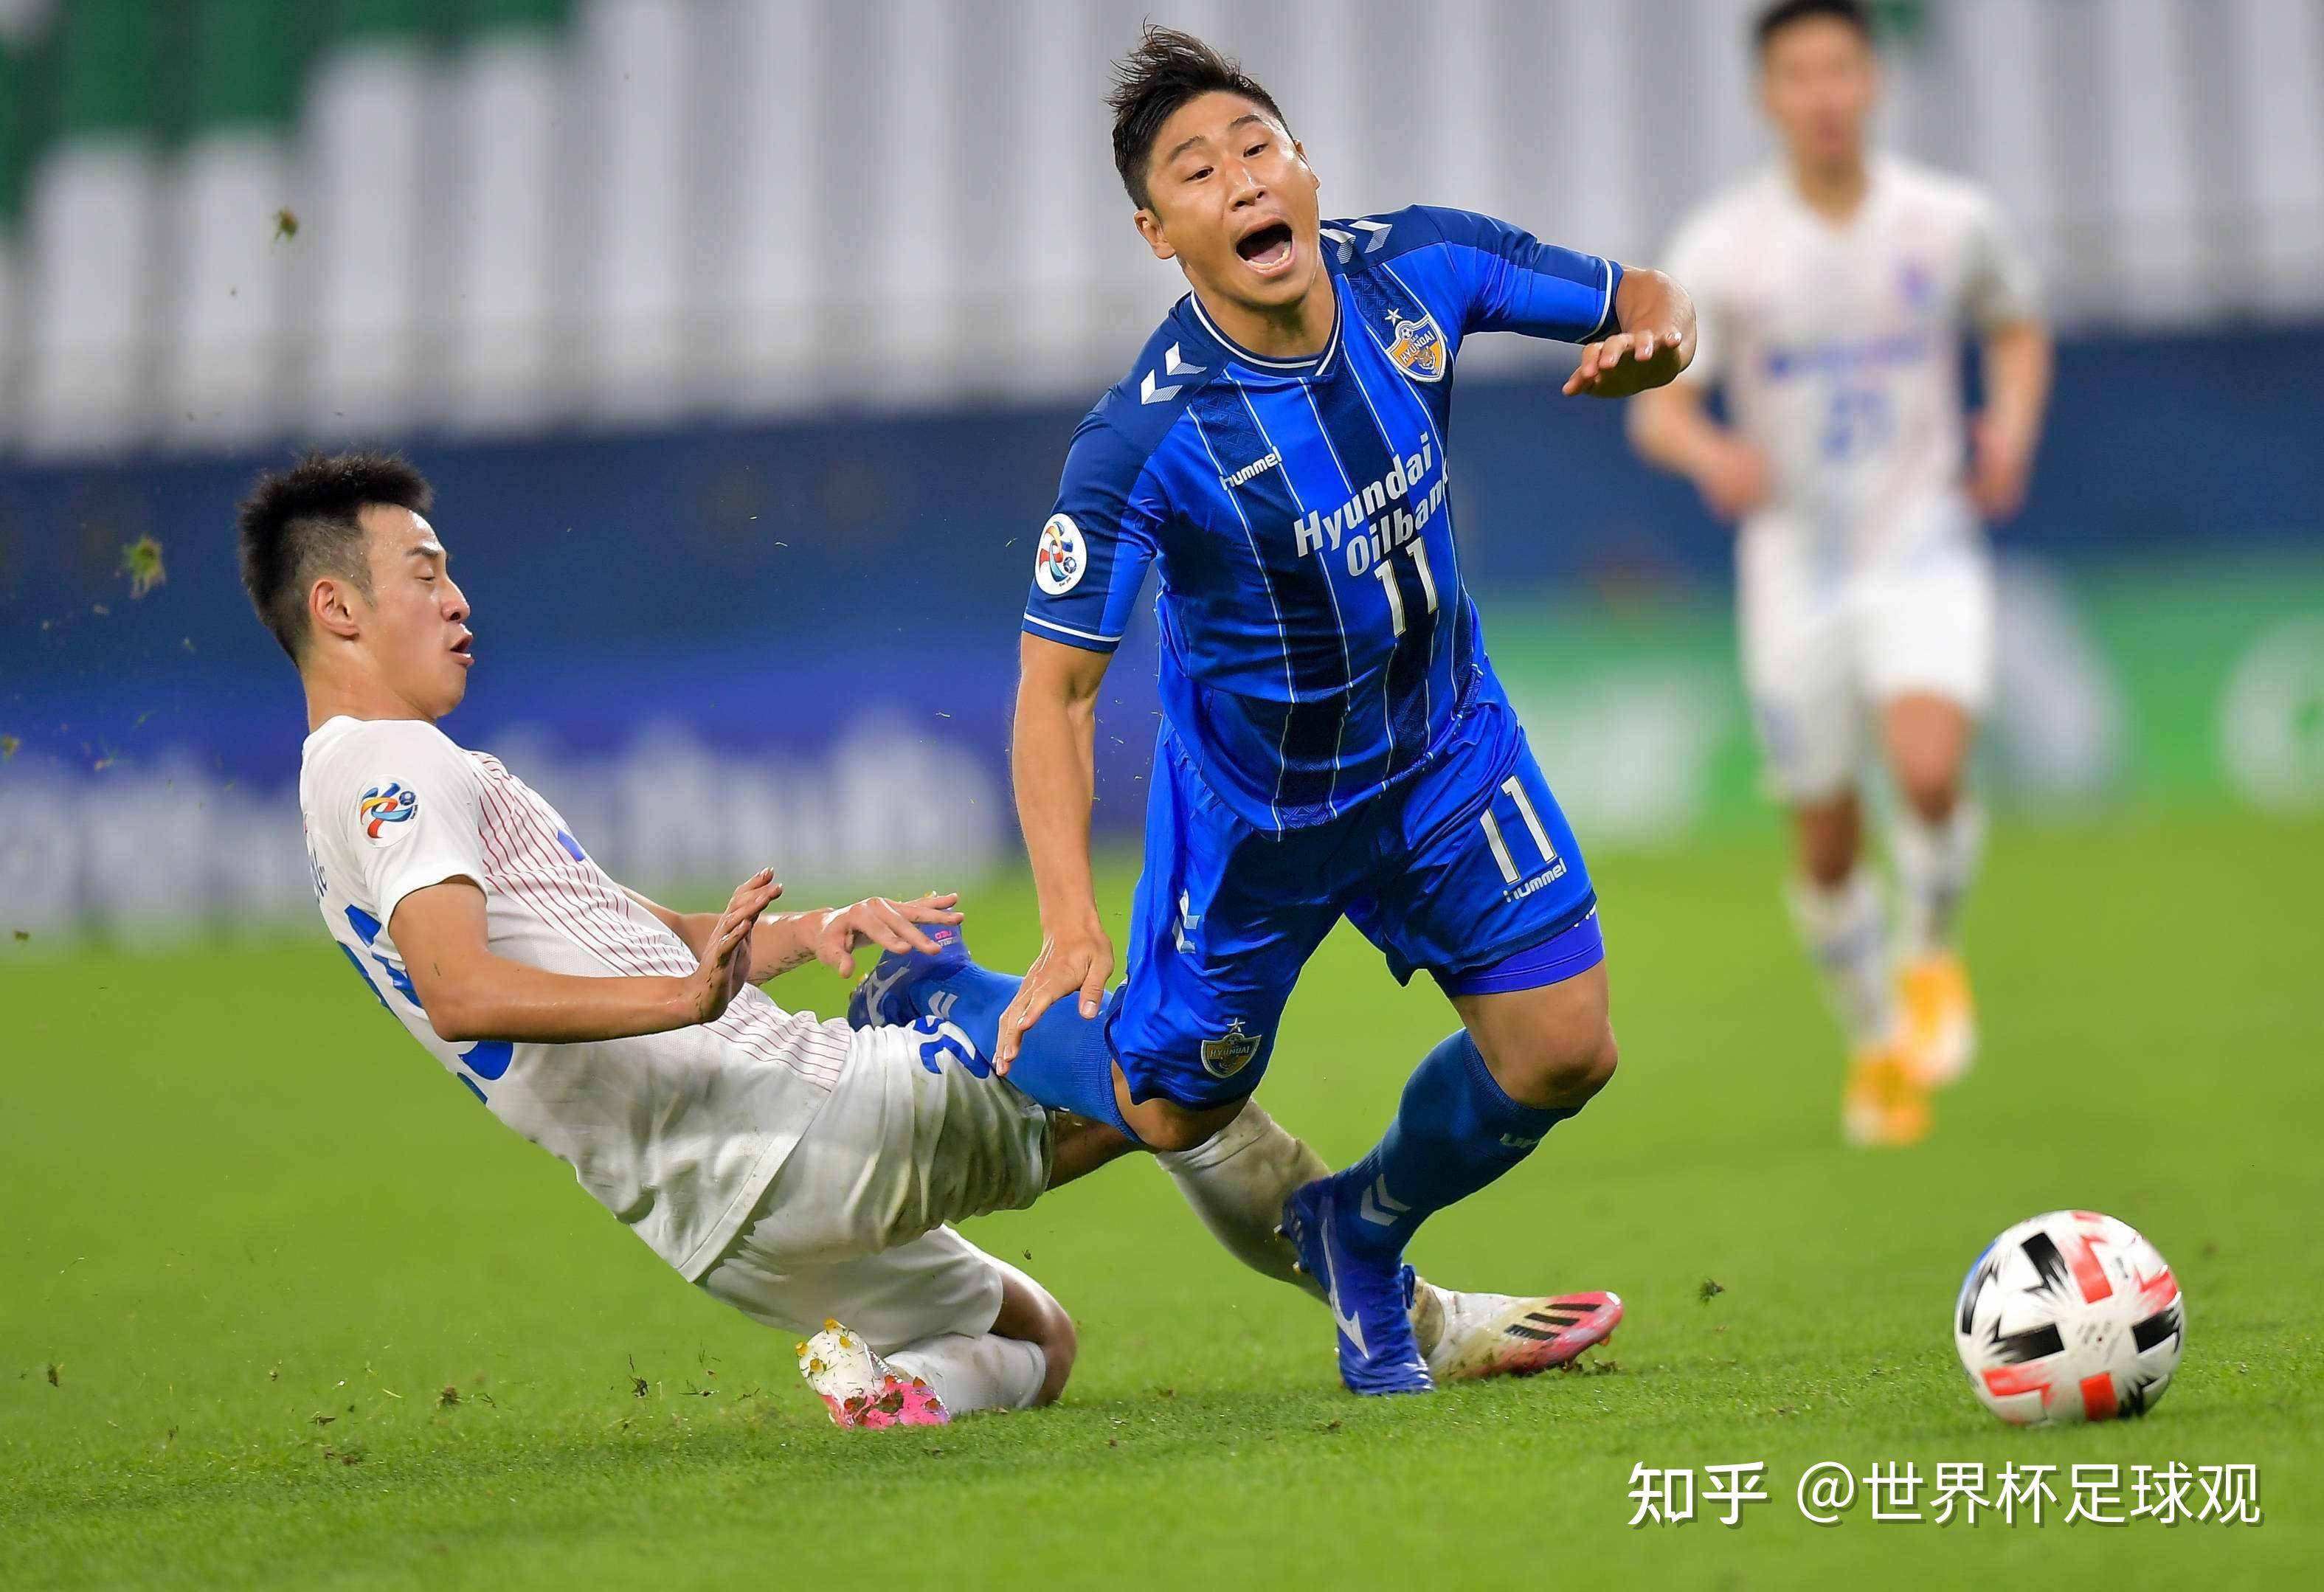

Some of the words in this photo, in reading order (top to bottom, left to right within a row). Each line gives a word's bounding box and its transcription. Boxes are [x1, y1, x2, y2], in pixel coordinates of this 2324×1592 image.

[1400, 330, 1435, 364] HYUNDAI
[1219, 445, 1282, 491] hummel
[1293, 431, 1432, 558] Hyundai
[1374, 536, 1438, 637] 11
[1479, 775, 1557, 885] 11
[1503, 857, 1567, 903] hummel
[1211, 1046, 1250, 1058] HYUNDAI
